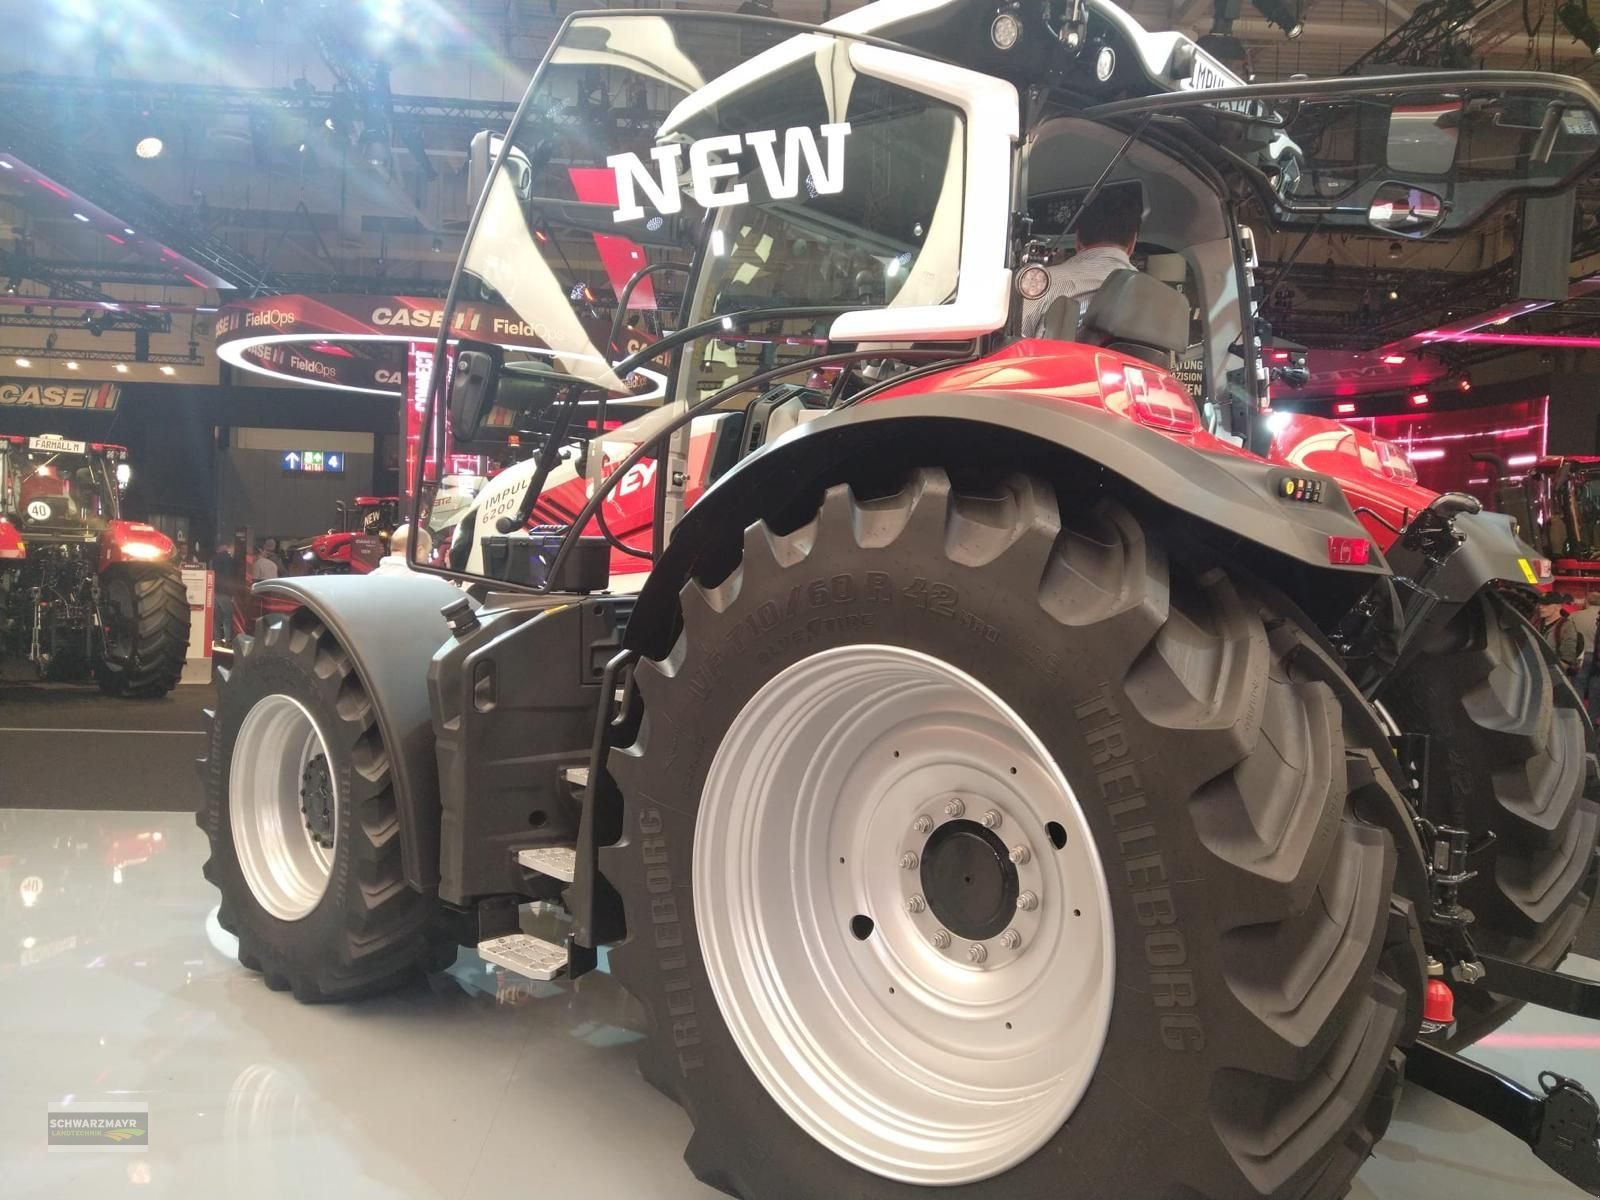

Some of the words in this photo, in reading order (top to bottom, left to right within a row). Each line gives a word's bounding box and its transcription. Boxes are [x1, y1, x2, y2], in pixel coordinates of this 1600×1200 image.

[606, 122, 852, 223] NEW
[215, 315, 230, 338] ASE
[245, 308, 296, 328] FieldOps
[290, 355, 337, 378] FieldOps
[374, 369, 402, 385] CA
[0, 383, 88, 407] CASE
[34, 439, 73, 452] FARMALL
[327, 455, 339, 469] 4
[485, 479, 529, 511] IMPUL
[30, 504, 48, 517] 40
[363, 509, 382, 527] NEW
[482, 499, 515, 524] 6200
[864, 569, 895, 603] R
[903, 575, 960, 621] 42
[1073, 680, 1206, 1052] TRELLEBORG
[639, 807, 707, 1079] TRELLEBORG
